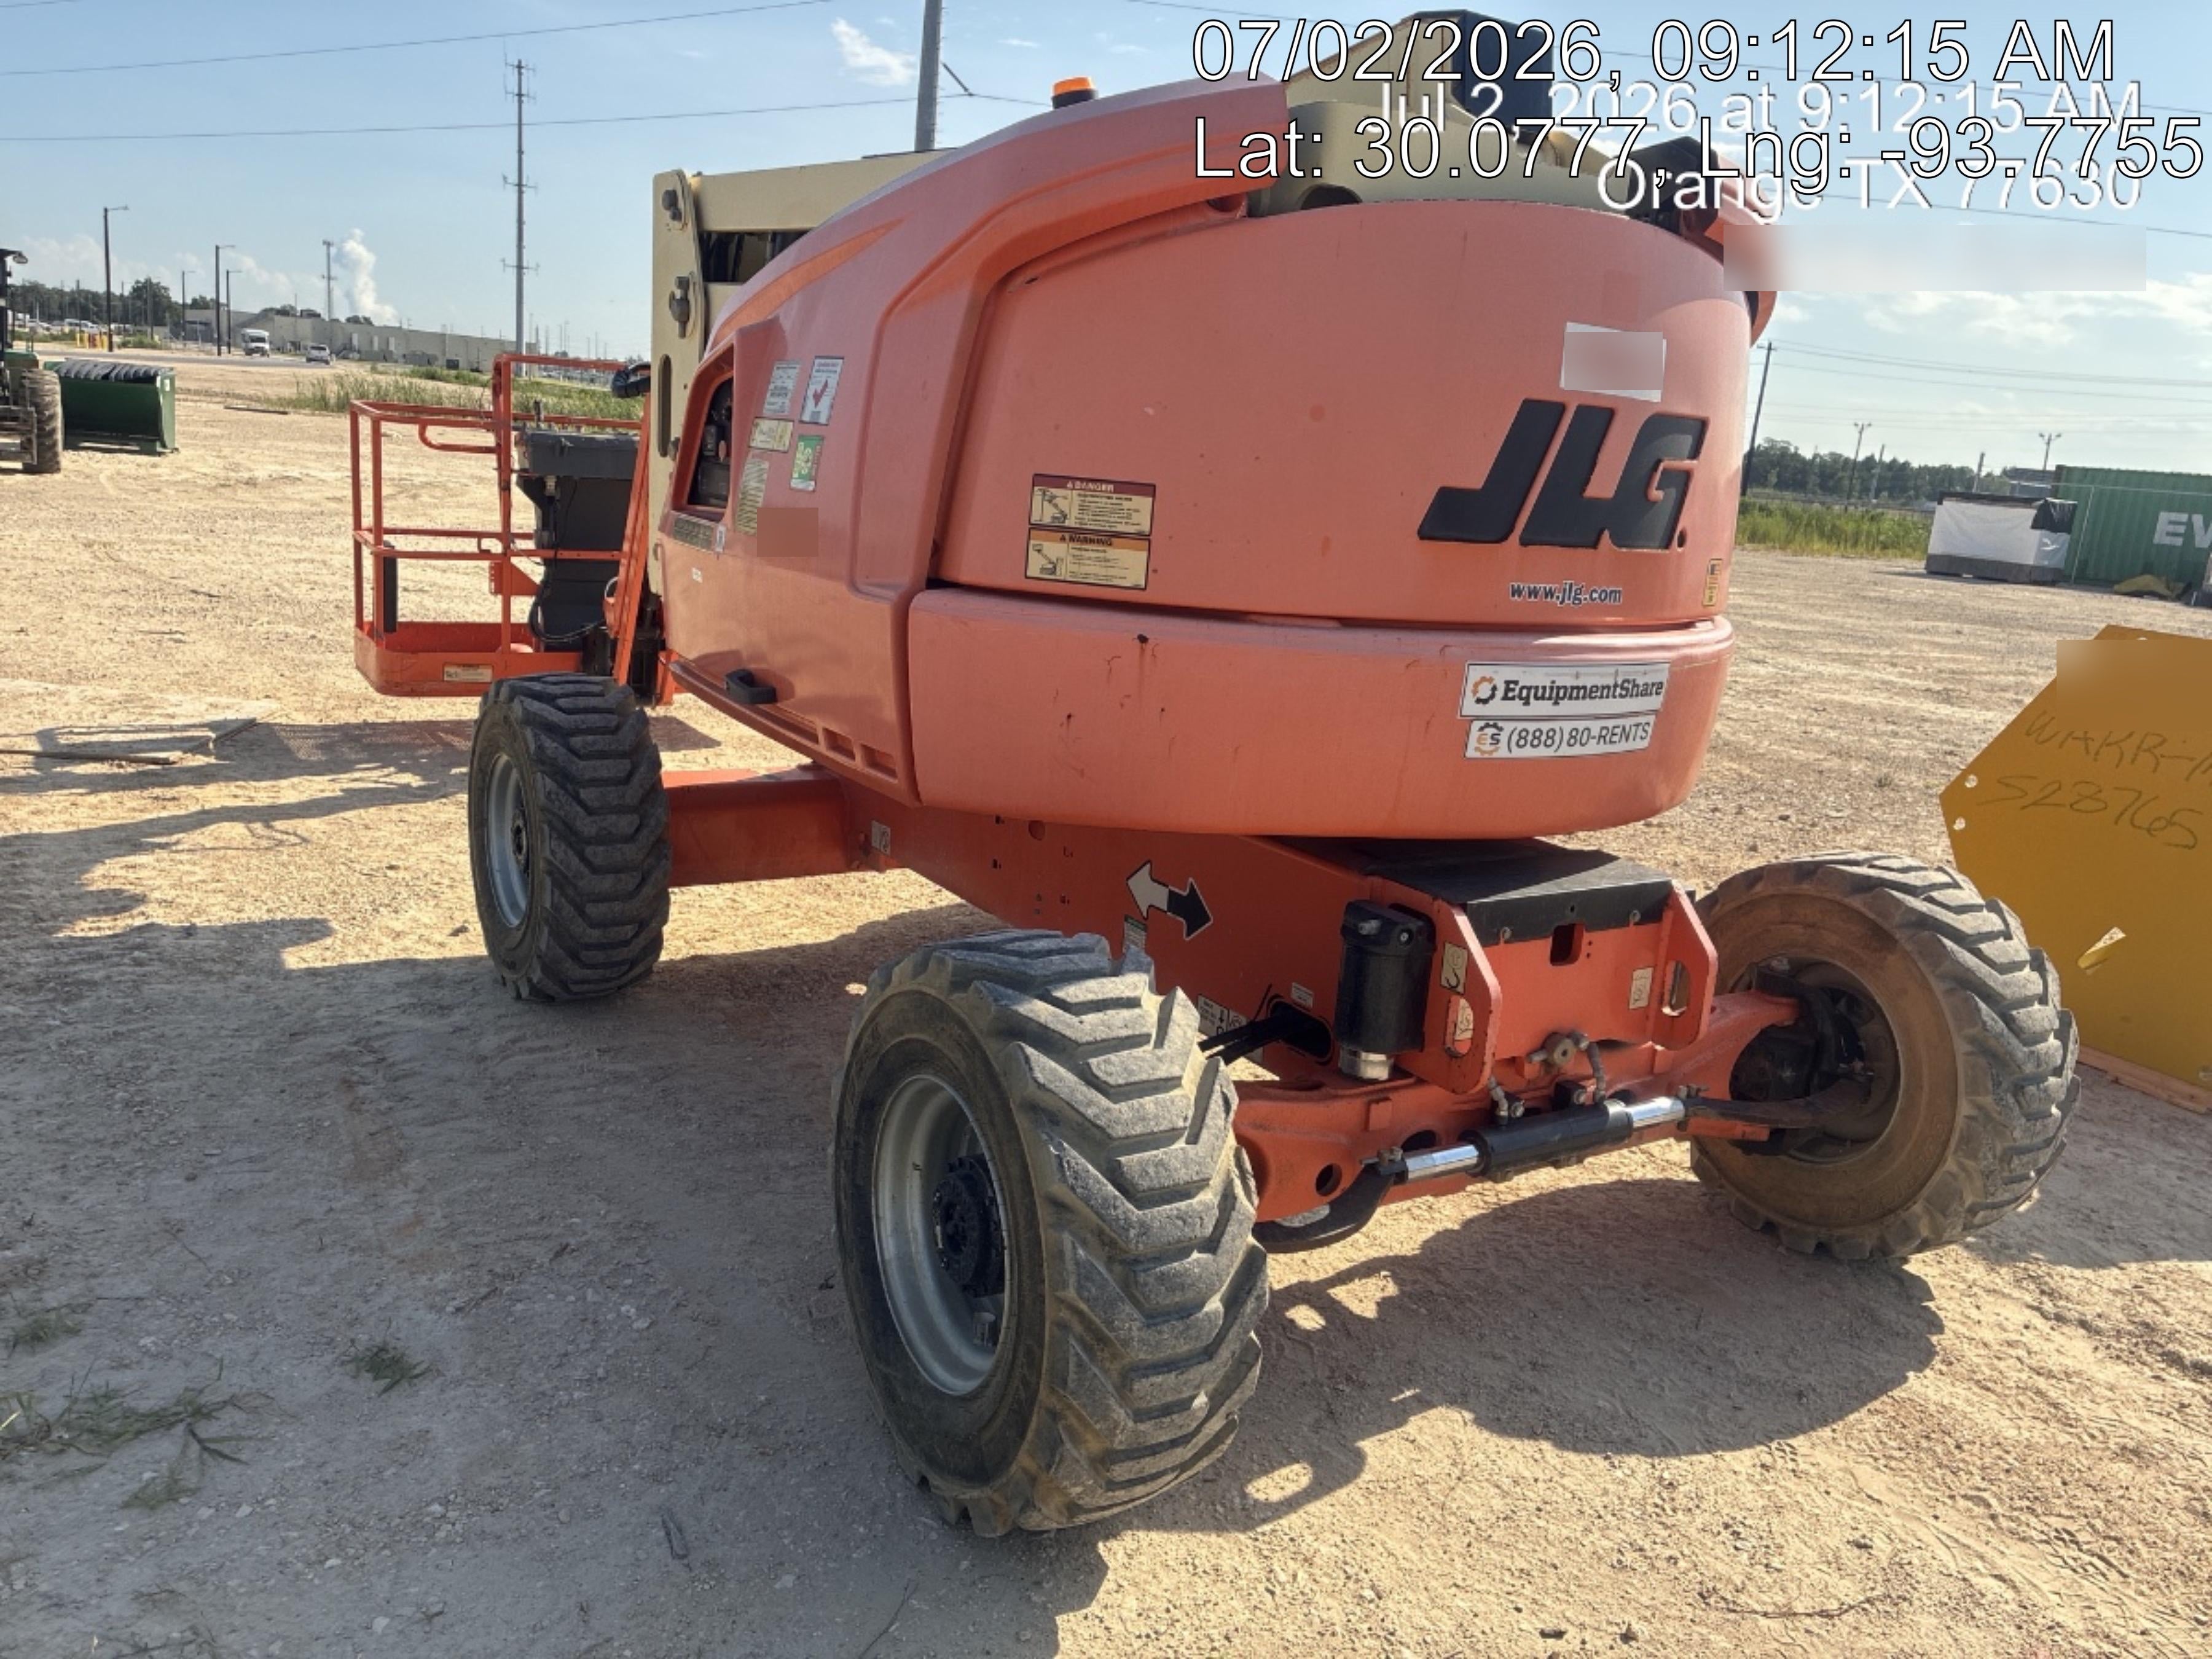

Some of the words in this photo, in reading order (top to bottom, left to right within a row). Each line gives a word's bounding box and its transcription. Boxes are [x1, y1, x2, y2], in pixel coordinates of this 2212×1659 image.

[1418, 398, 1709, 551] JLG
[1069, 534, 1112, 546] WARNING
[1509, 581, 1623, 606] www.jlg.com
[1500, 678, 1663, 706] EquipmentShare
[1507, 726, 1564, 753] (888)
[1566, 721, 1650, 748] 80-RENTS
